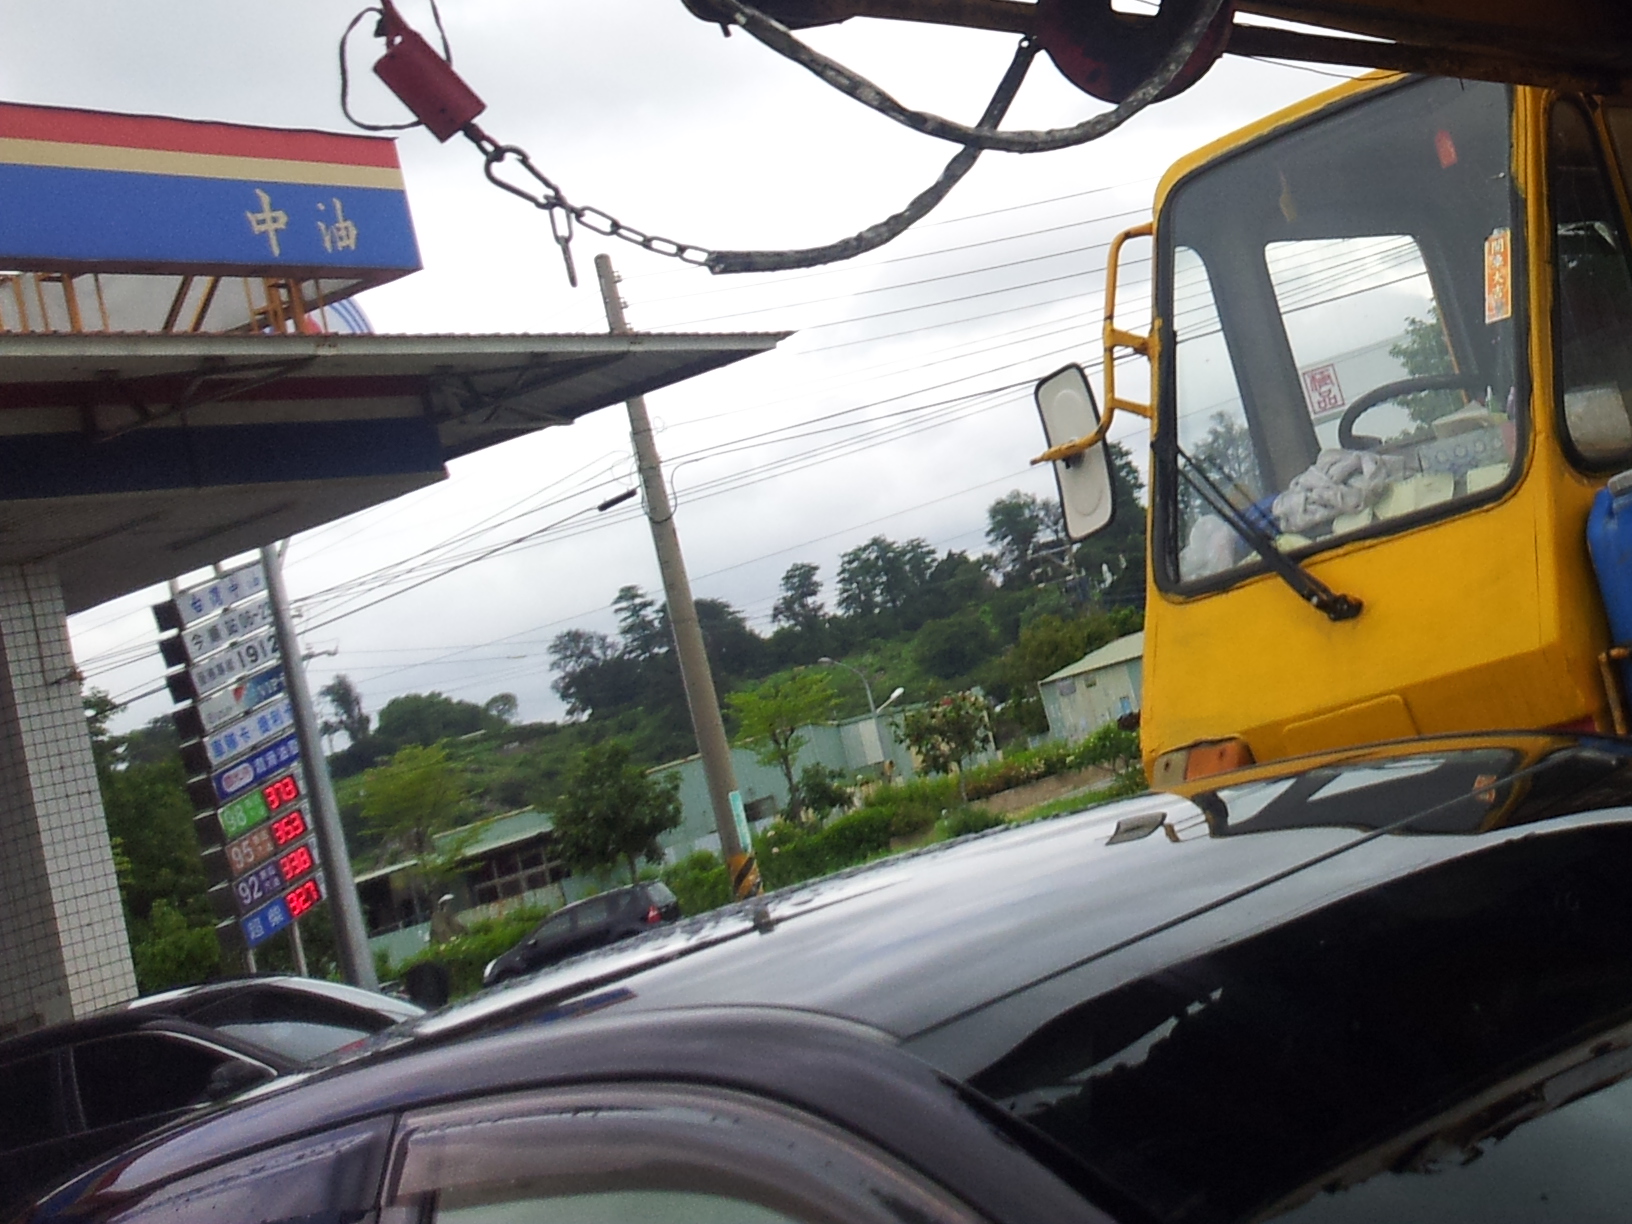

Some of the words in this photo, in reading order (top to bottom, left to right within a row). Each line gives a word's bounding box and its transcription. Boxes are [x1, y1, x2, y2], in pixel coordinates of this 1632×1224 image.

[245, 188, 357, 257] 中油
[223, 805, 247, 831] 98
[264, 776, 299, 810] 373
[231, 836, 255, 869] 95
[272, 811, 304, 845] 353
[238, 876, 263, 905] 92
